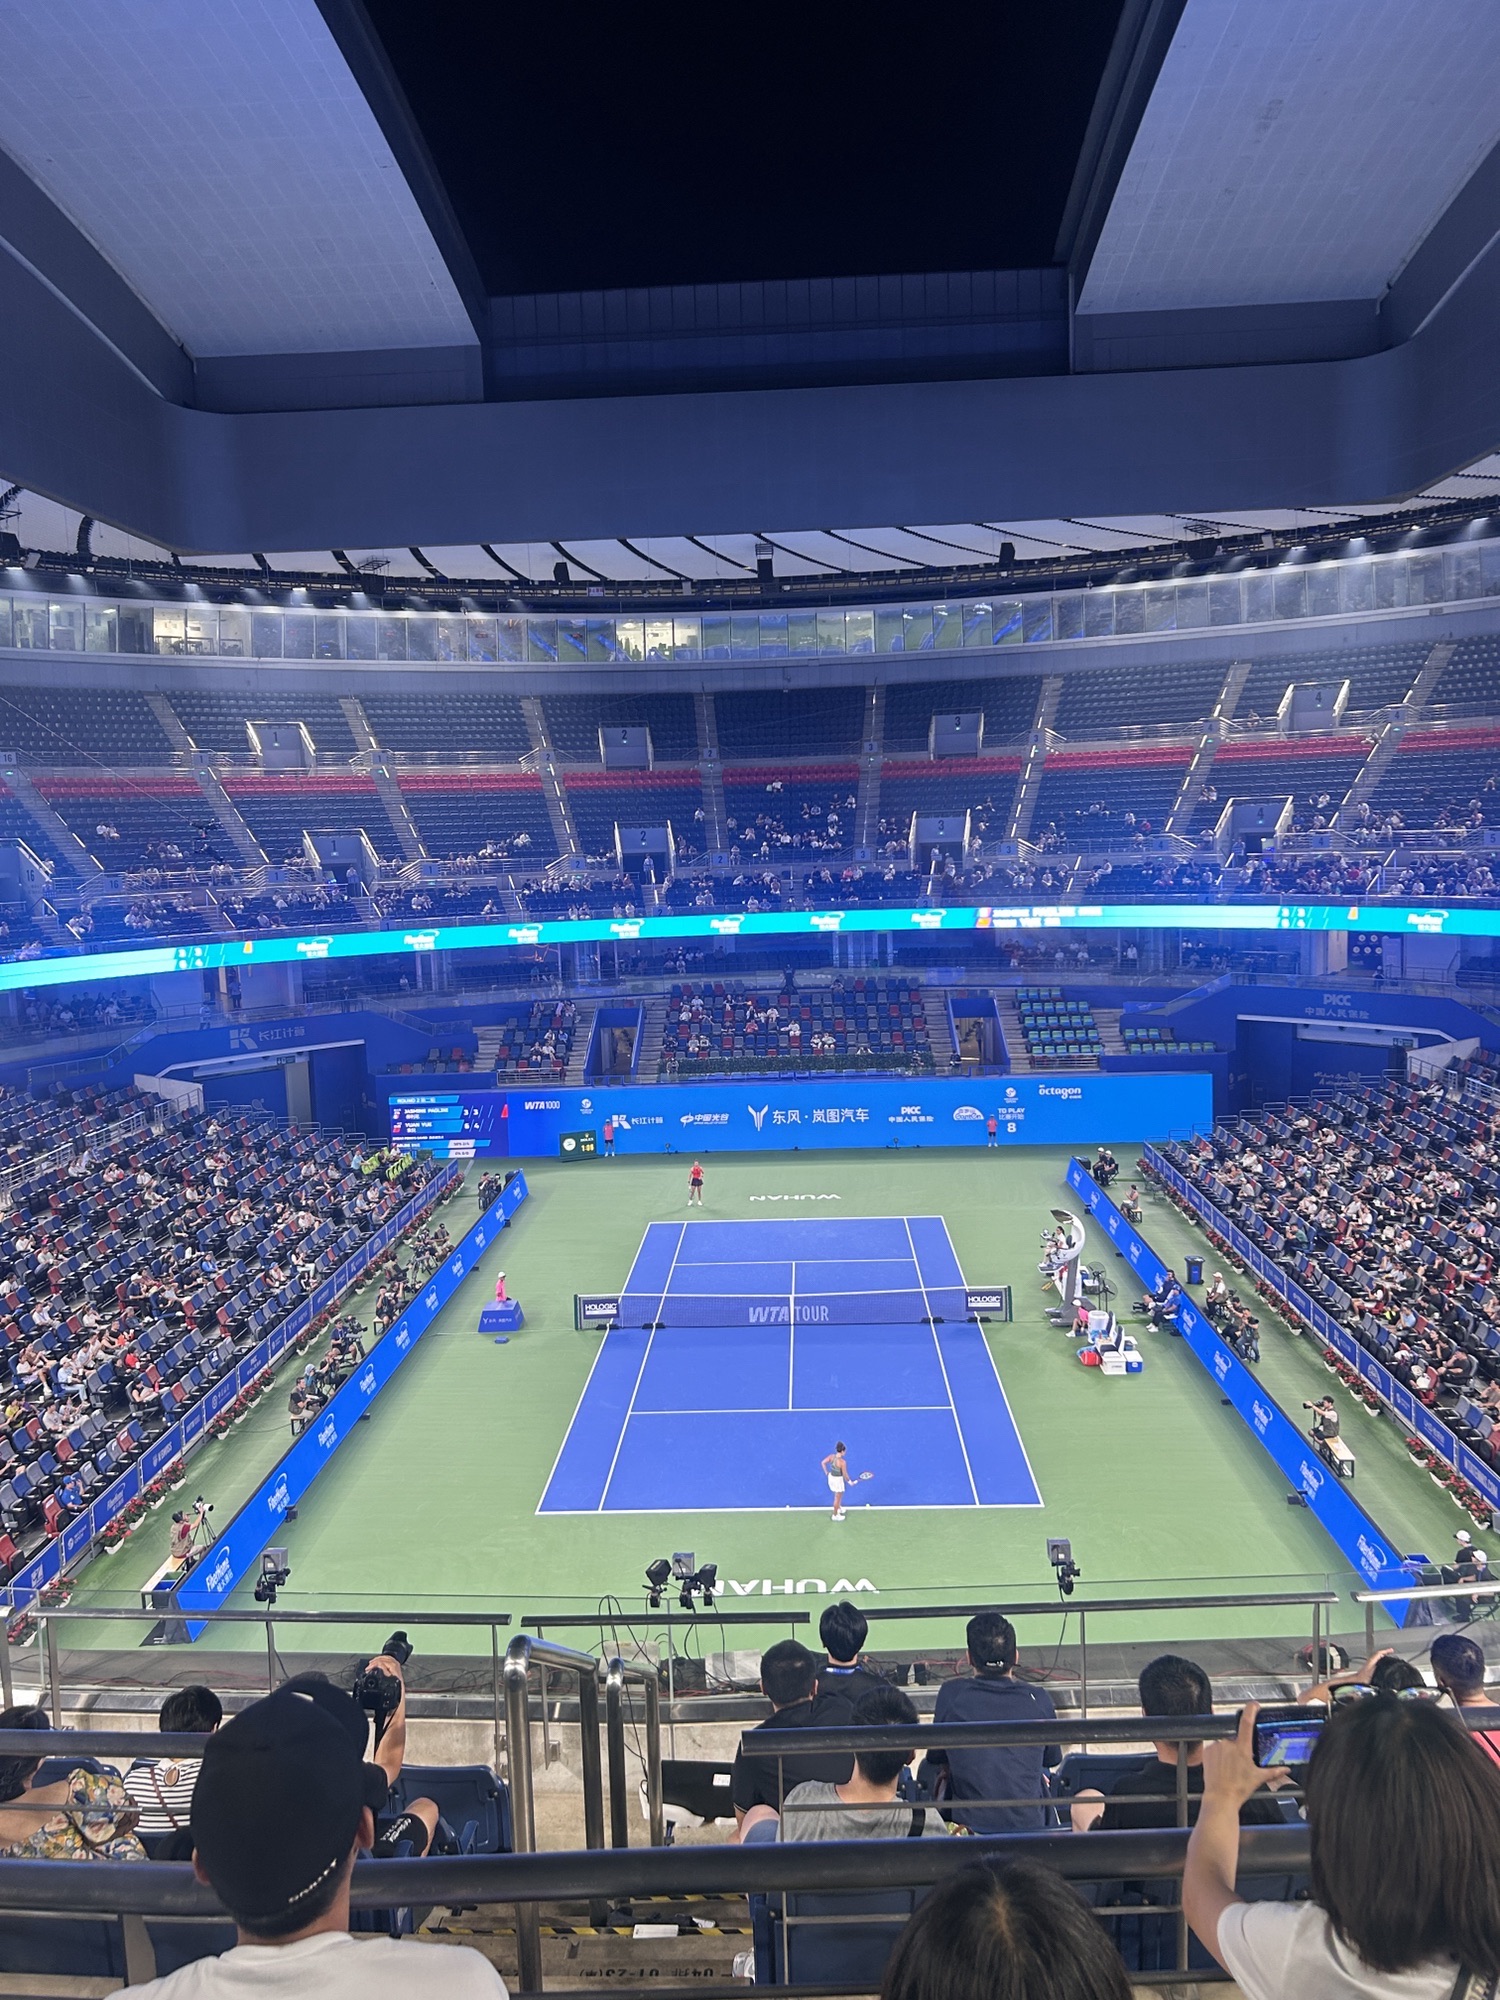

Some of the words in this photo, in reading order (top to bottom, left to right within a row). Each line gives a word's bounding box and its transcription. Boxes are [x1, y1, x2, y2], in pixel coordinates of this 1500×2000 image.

[1316, 692, 1322, 702] 4
[955, 716, 960, 726] 3
[622, 730, 628, 740] 2
[3, 754, 12, 763] 16
[1257, 807, 1264, 819] 4
[938, 820, 944, 831] 3
[640, 830, 646, 841] 2
[1490, 834, 1496, 844] 5
[1318, 837, 1324, 846] 4
[718, 855, 724, 864] 2
[575, 861, 580, 870] 2
[26, 870, 34, 881] 16
[110, 880, 118, 888] 16
[1324, 994, 1351, 1006] PICC
[1305, 1006, 1370, 1020] 中国人民保险
[1039, 1087, 1082, 1100] octagon
[901, 1106, 921, 1115] PICC
[1007, 1123, 1016, 1133] 8
[748, 1306, 790, 1323] WTA
[794, 1305, 829, 1322] TOUR
[206, 1557, 230, 1592] FiberHome
[692, 1578, 880, 1597] WUHAN
